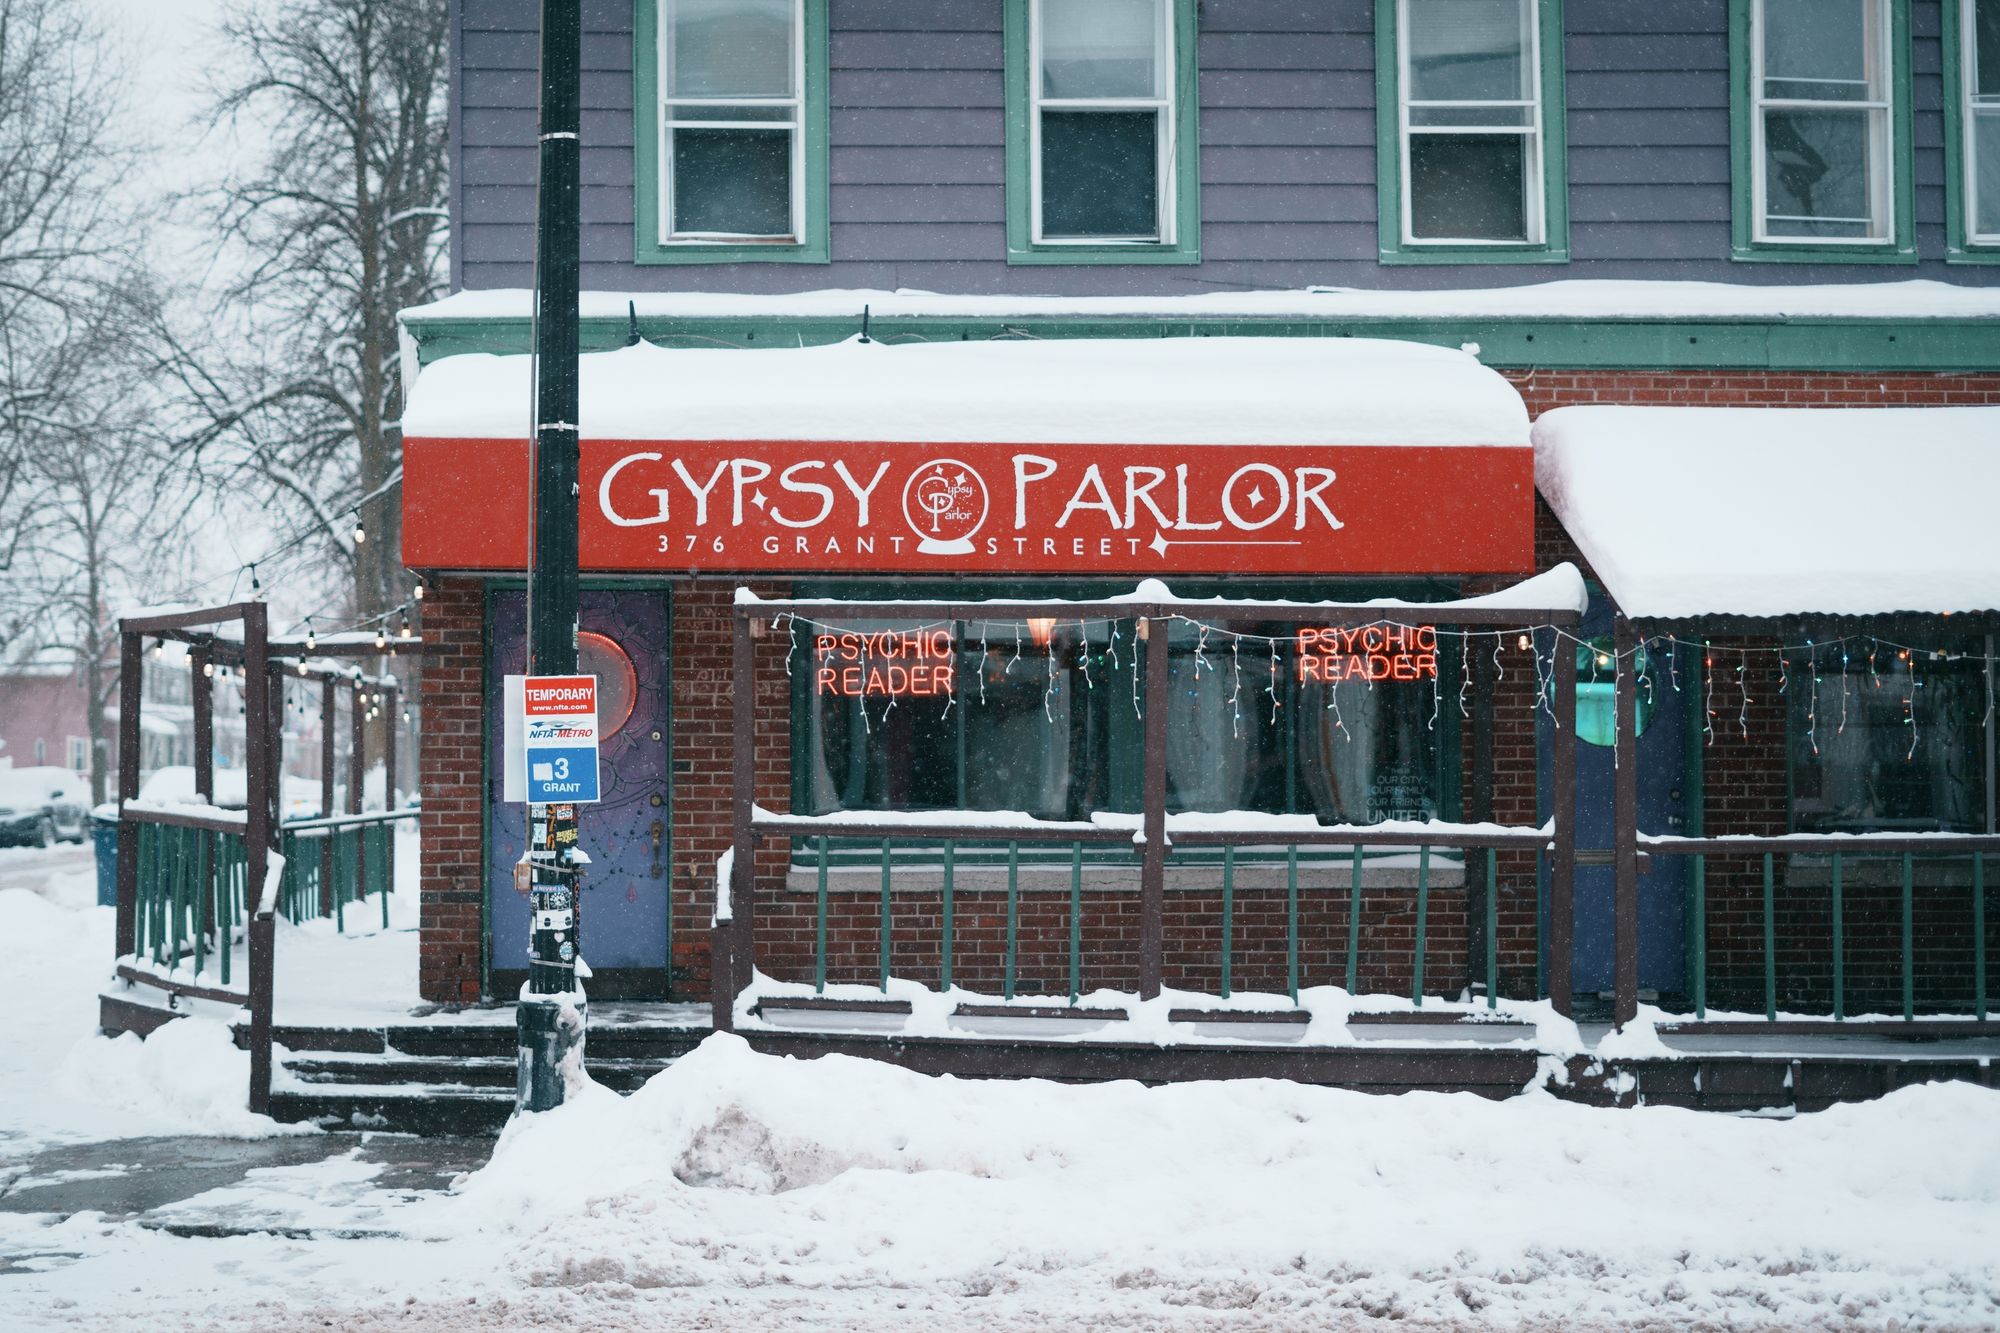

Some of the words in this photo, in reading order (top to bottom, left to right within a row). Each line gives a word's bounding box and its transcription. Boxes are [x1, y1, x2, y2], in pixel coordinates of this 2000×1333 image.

[599, 452, 891, 528] GYPSY
[1011, 453, 1345, 532] PARLOR
[657, 534, 725, 553] 376
[762, 536, 905, 554] GRANT
[987, 537, 1141, 556] STREET
[817, 630, 953, 662] PSYCHIC
[1298, 625, 1437, 654] PSYCHIC
[1298, 654, 1437, 681] READER
[817, 665, 953, 696] READER
[526, 688, 593, 701] TEMPORARY
[529, 729, 593, 739] NFTA-METRO
[554, 757, 570, 780] 3
[542, 783, 581, 793] GRANT
